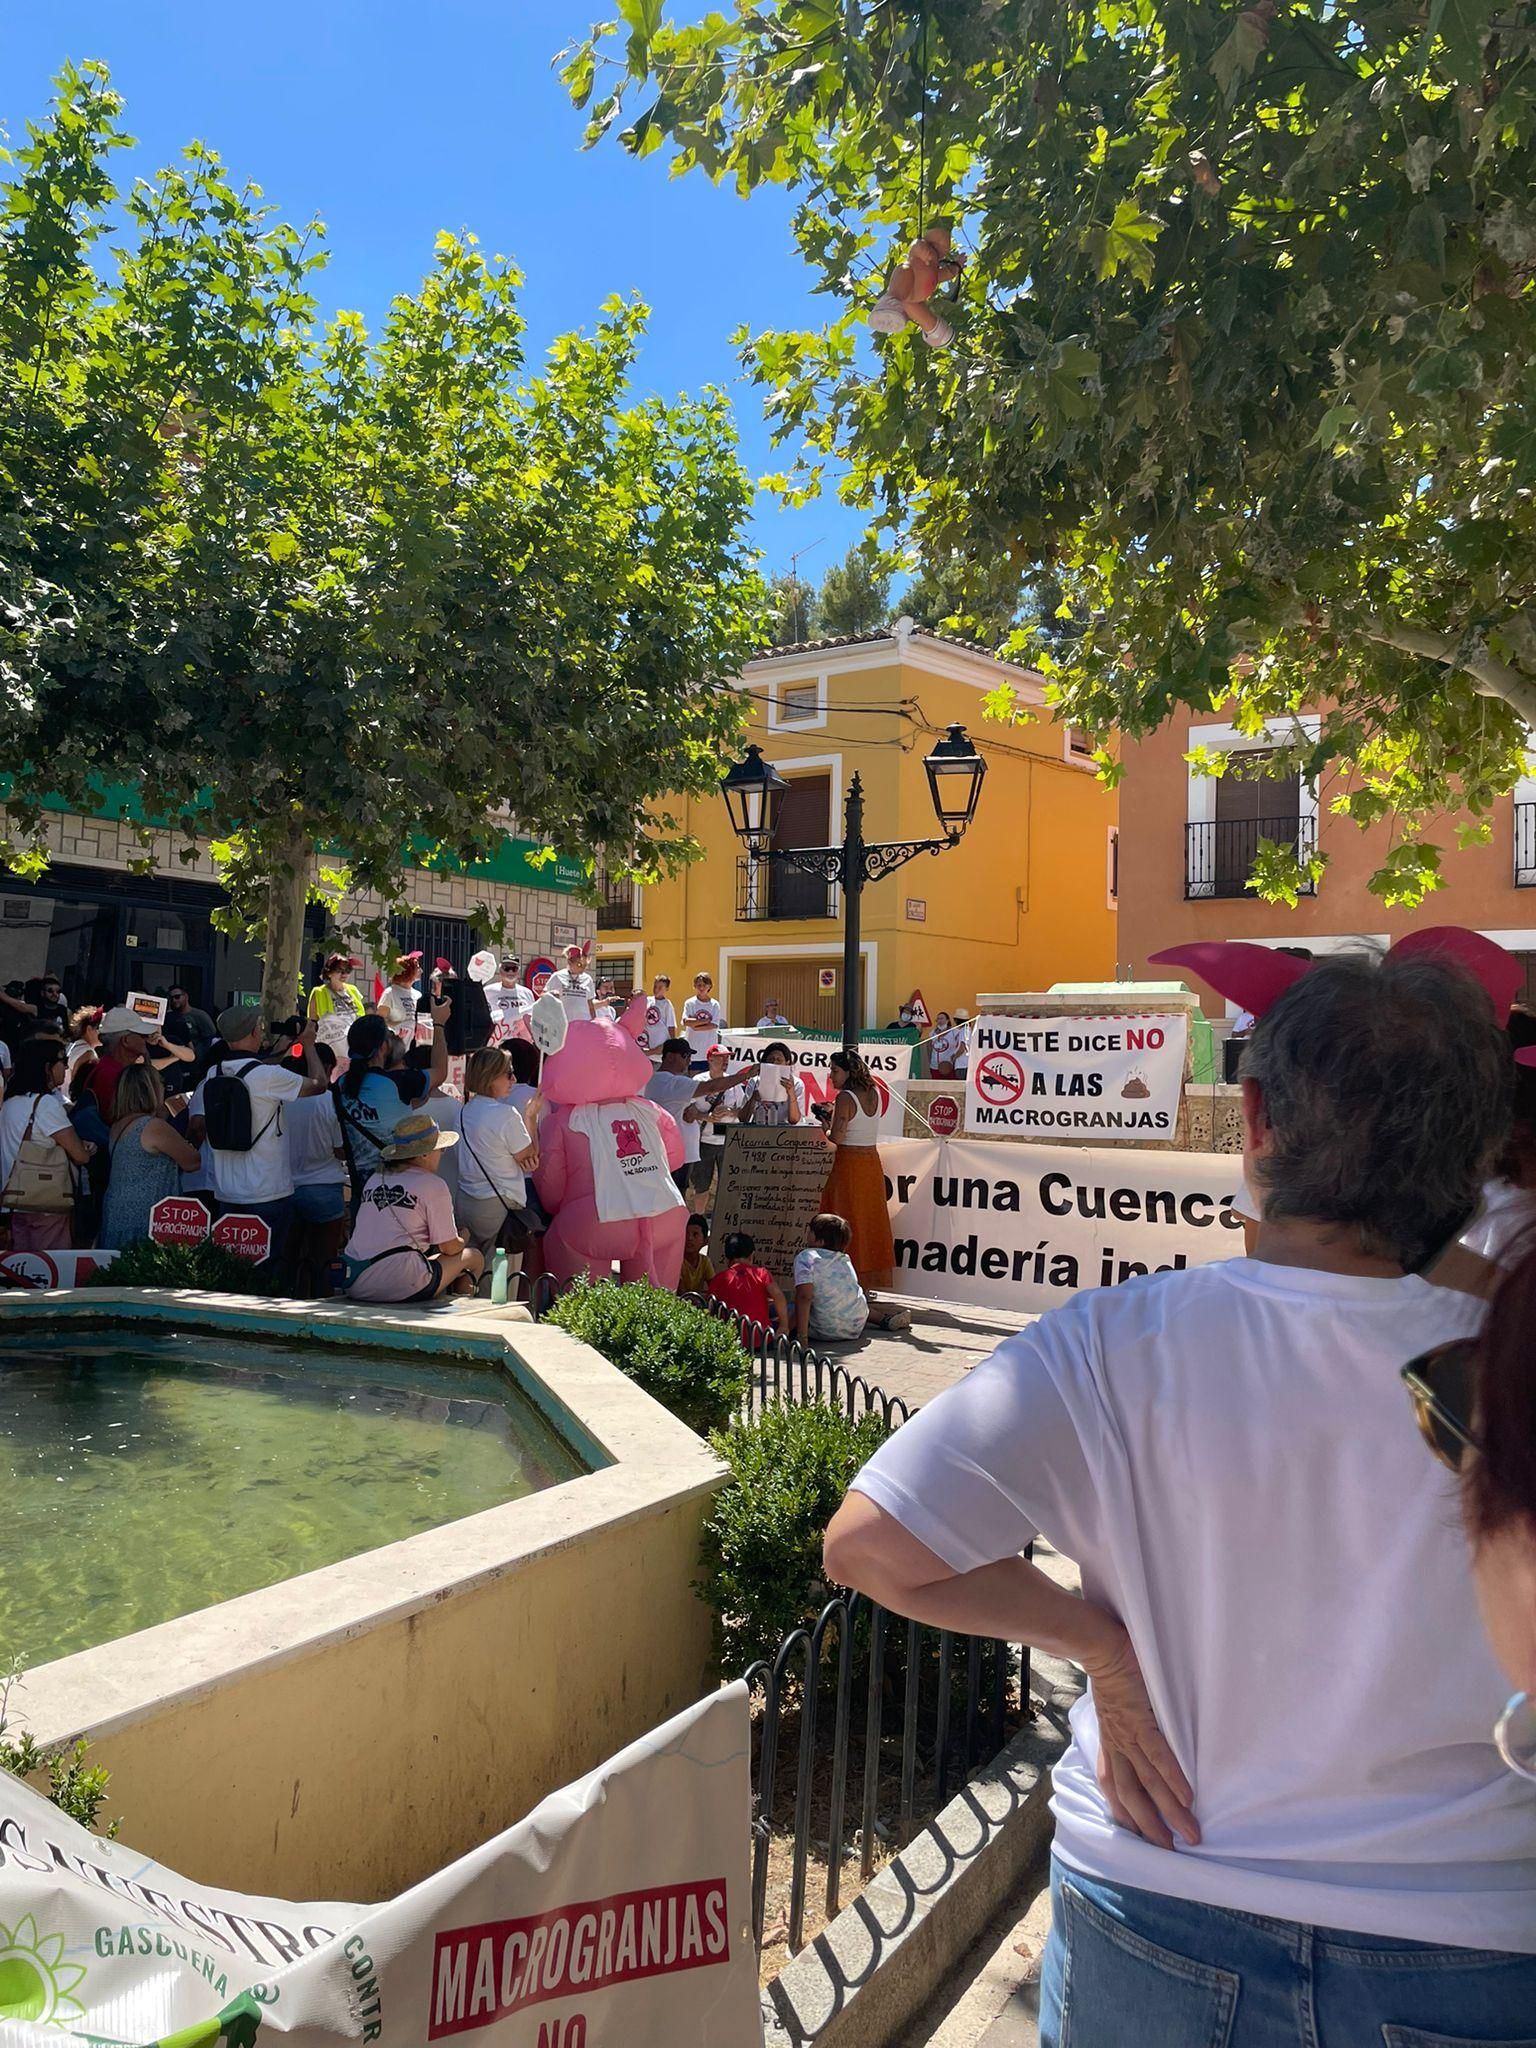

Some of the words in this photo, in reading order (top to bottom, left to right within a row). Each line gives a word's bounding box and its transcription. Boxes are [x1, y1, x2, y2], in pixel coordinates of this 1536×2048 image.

[977, 1029, 1059, 1052] HUETE
[1068, 1035, 1121, 1051] DICE
[1126, 1029, 1165, 1050] NO
[1031, 1072, 1047, 1096] A
[1055, 1073, 1103, 1096] LAS
[934, 1105, 953, 1116] STOP
[976, 1107, 1169, 1128] MACROGRANJAS
[620, 1156, 643, 1168] STOP
[933, 1176, 1020, 1212] una
[1039, 1172, 1246, 1229] Cuenca
[161, 1207, 199, 1220] STOP
[152, 1221, 208, 1237] MACROGRANJAS
[221, 1227, 259, 1242] STOP
[94, 1926, 228, 1999] GASCUEÑA
[435, 1890, 727, 2026] MACROGRANJAS
